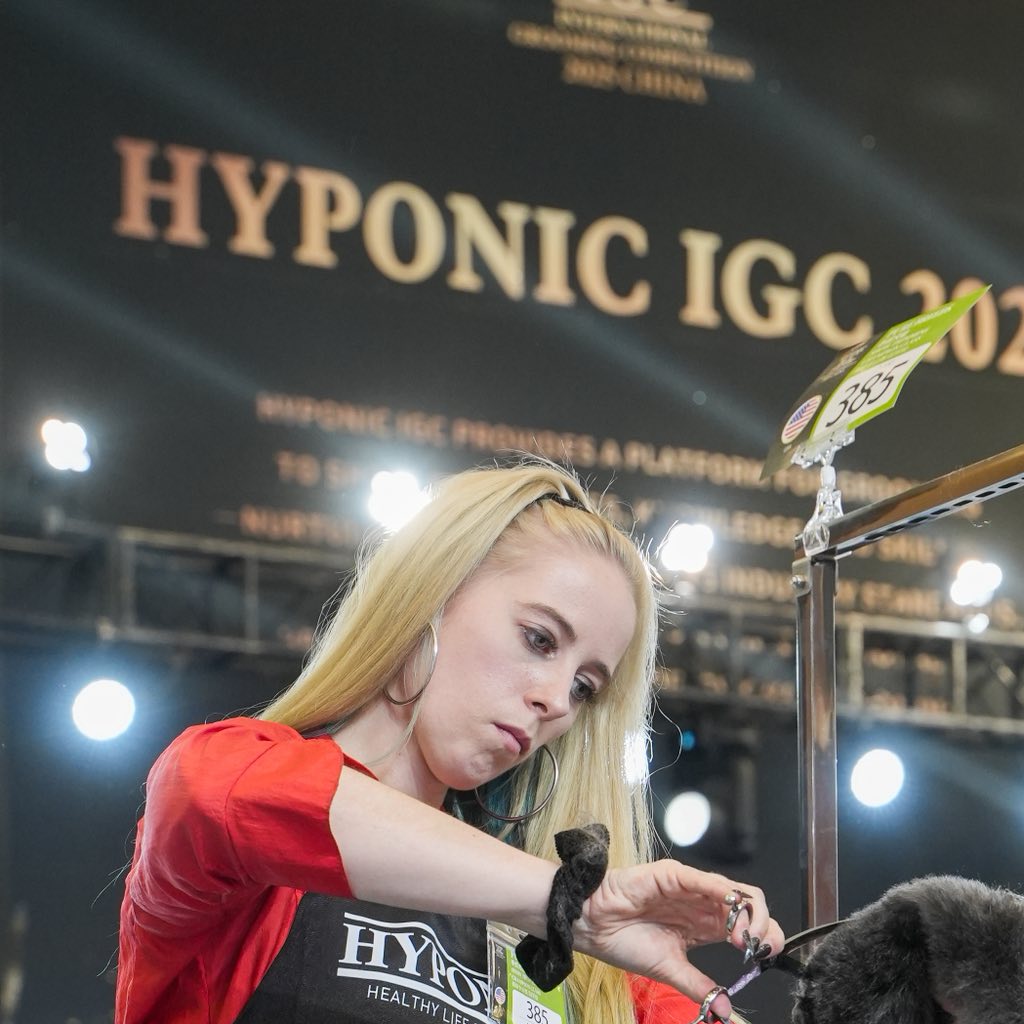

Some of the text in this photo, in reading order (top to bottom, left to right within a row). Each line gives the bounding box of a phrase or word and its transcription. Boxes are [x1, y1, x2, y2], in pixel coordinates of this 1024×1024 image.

[112, 135, 653, 318] HYPONIC
[678, 228, 873, 350] IGC
[825, 360, 908, 428] 385
[367, 984, 440, 1018] HEALTHY
